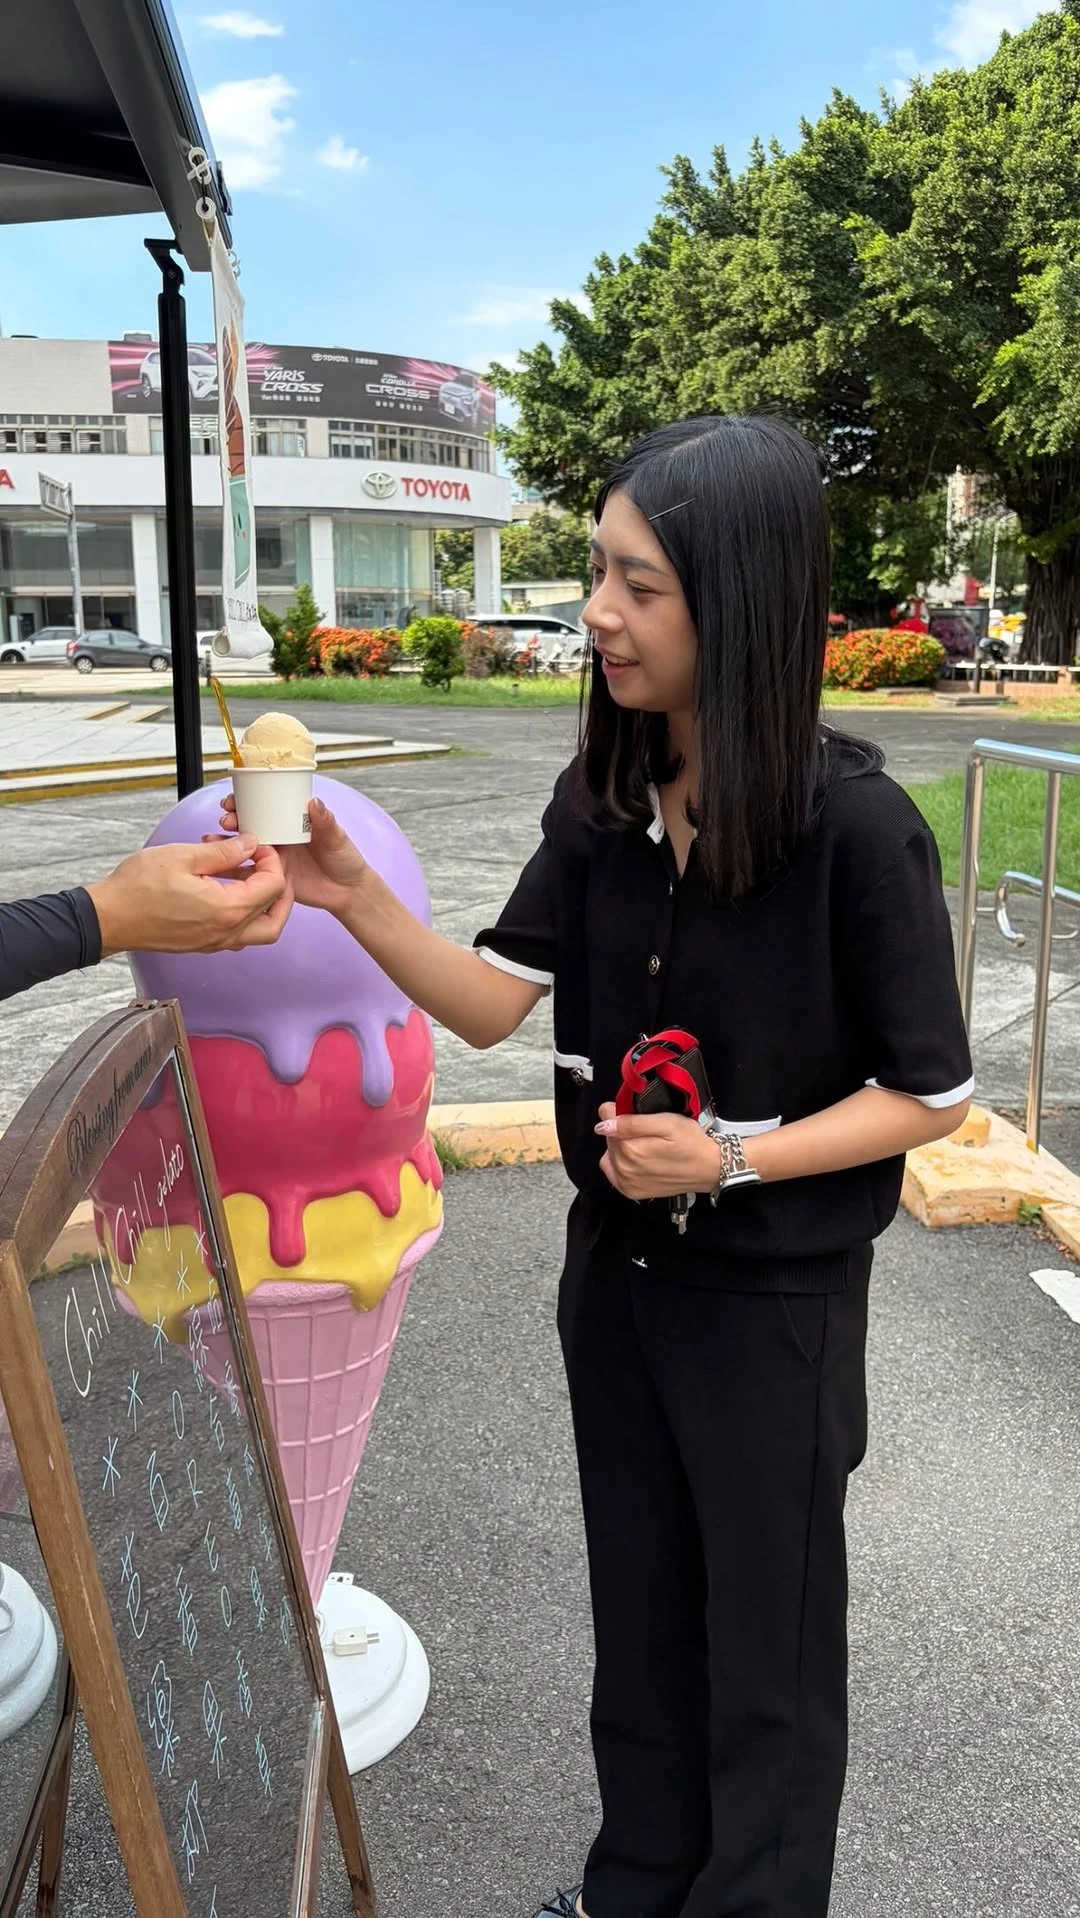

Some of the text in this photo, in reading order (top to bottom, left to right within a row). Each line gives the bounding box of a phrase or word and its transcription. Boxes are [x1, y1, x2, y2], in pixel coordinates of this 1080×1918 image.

[260, 381, 324, 394] CROSS
[365, 383, 431, 400] CROSS
[401, 477, 471, 502] TOYOTA
[64, 1137, 184, 1397] Chill Chill gelato
[146, 1450, 228, 1780] 百香果
